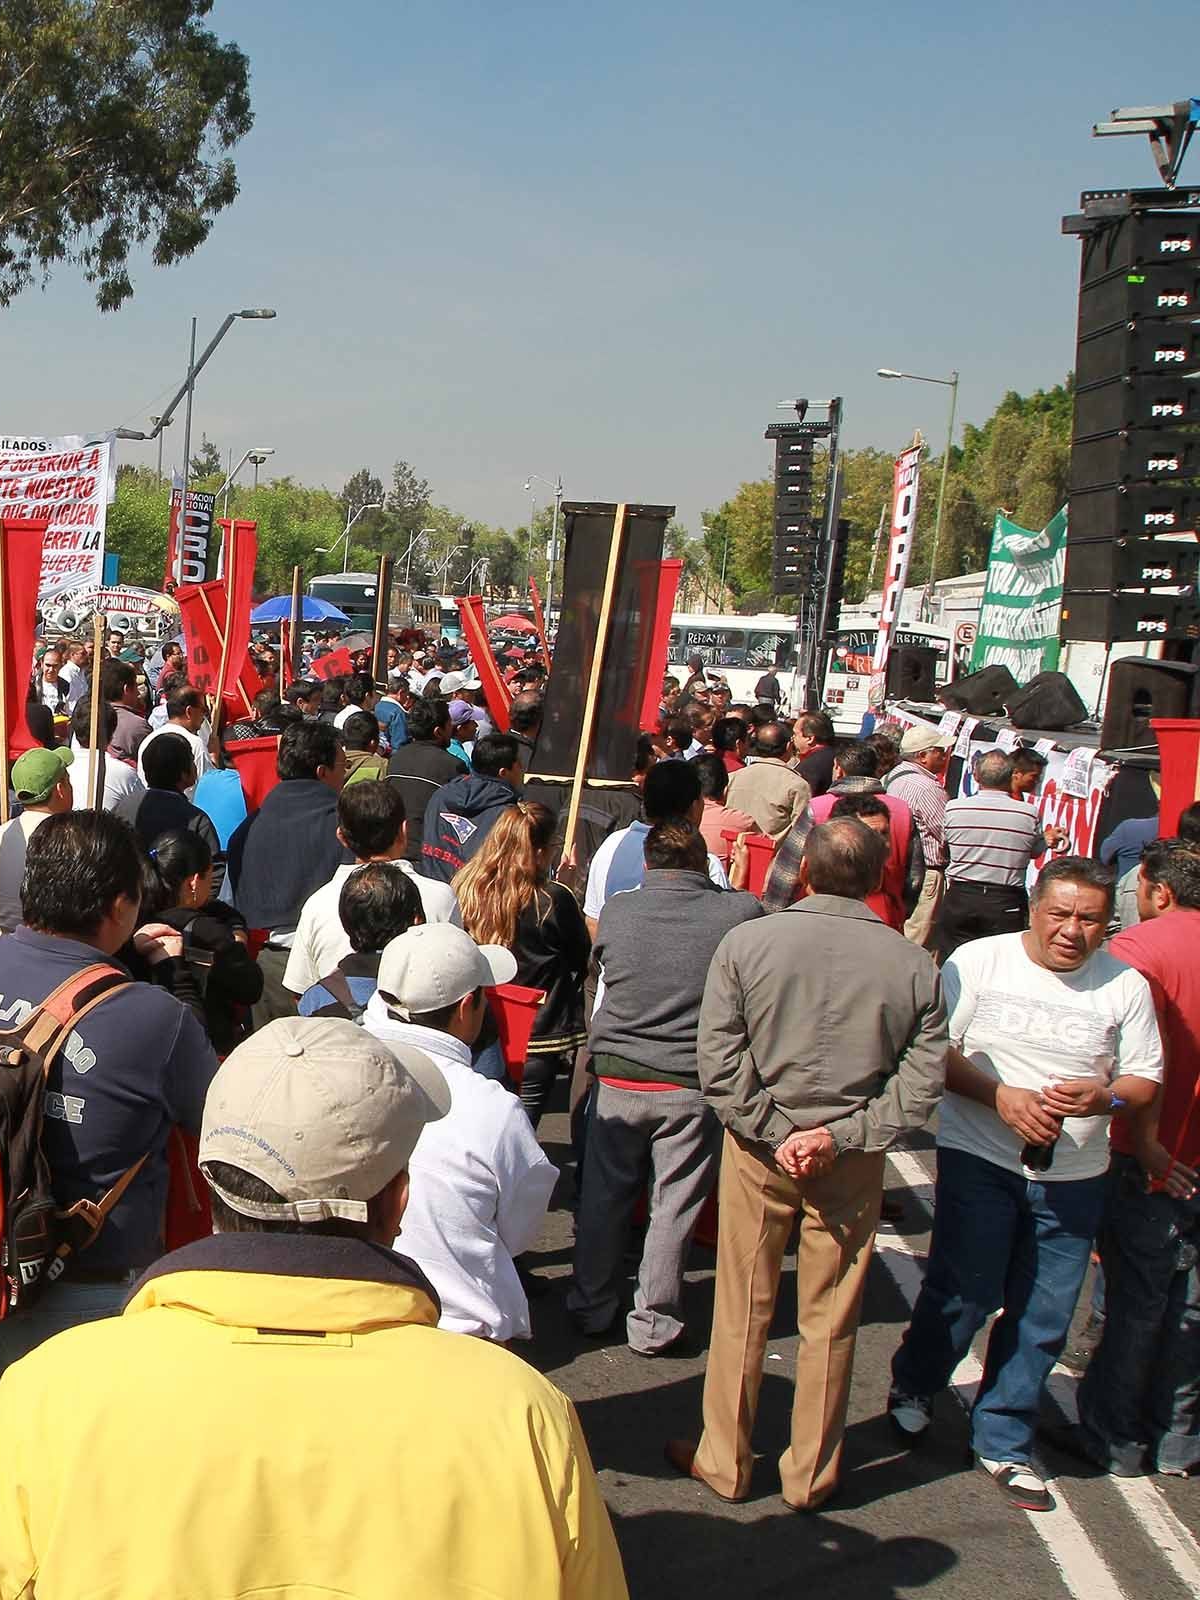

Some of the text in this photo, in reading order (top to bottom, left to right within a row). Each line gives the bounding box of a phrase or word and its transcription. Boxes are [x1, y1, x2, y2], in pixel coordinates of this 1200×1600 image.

[1161, 240, 1191, 252] PPS
[1157, 295, 1188, 307] PPS
[1155, 350, 1185, 362] PPS
[1152, 405, 1182, 417] PPS
[87, 448, 100, 470] A
[1148, 459, 1178, 471] PPS
[23, 475, 96, 500] NUESTRO
[174, 490, 214, 504] FEERACION
[1145, 514, 1175, 525] PPS
[82, 530, 101, 550] LA
[1142, 568, 1172, 580] PPS
[1137, 621, 1167, 633] PPS
[687, 632, 727, 645] REFORMA
